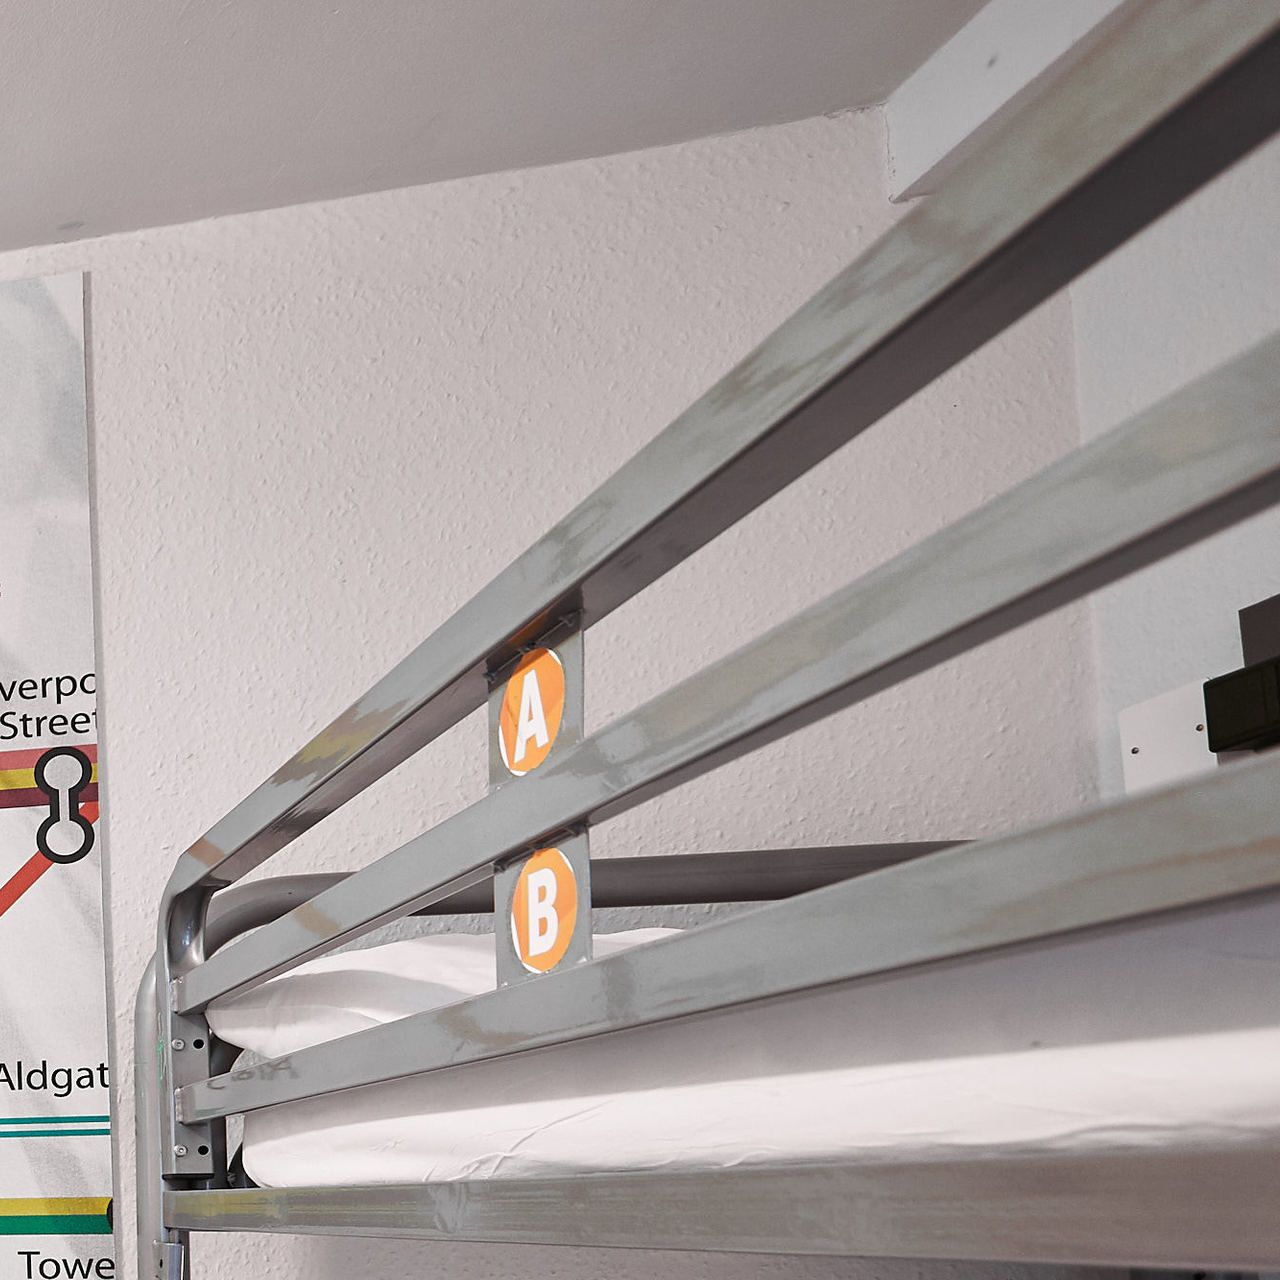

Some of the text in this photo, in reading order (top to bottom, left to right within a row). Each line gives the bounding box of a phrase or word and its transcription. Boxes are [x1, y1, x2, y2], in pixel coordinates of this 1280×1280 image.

[514, 669, 548, 764] A
[527, 867, 558, 957] B
[17, 1251, 116, 1280] Towe
